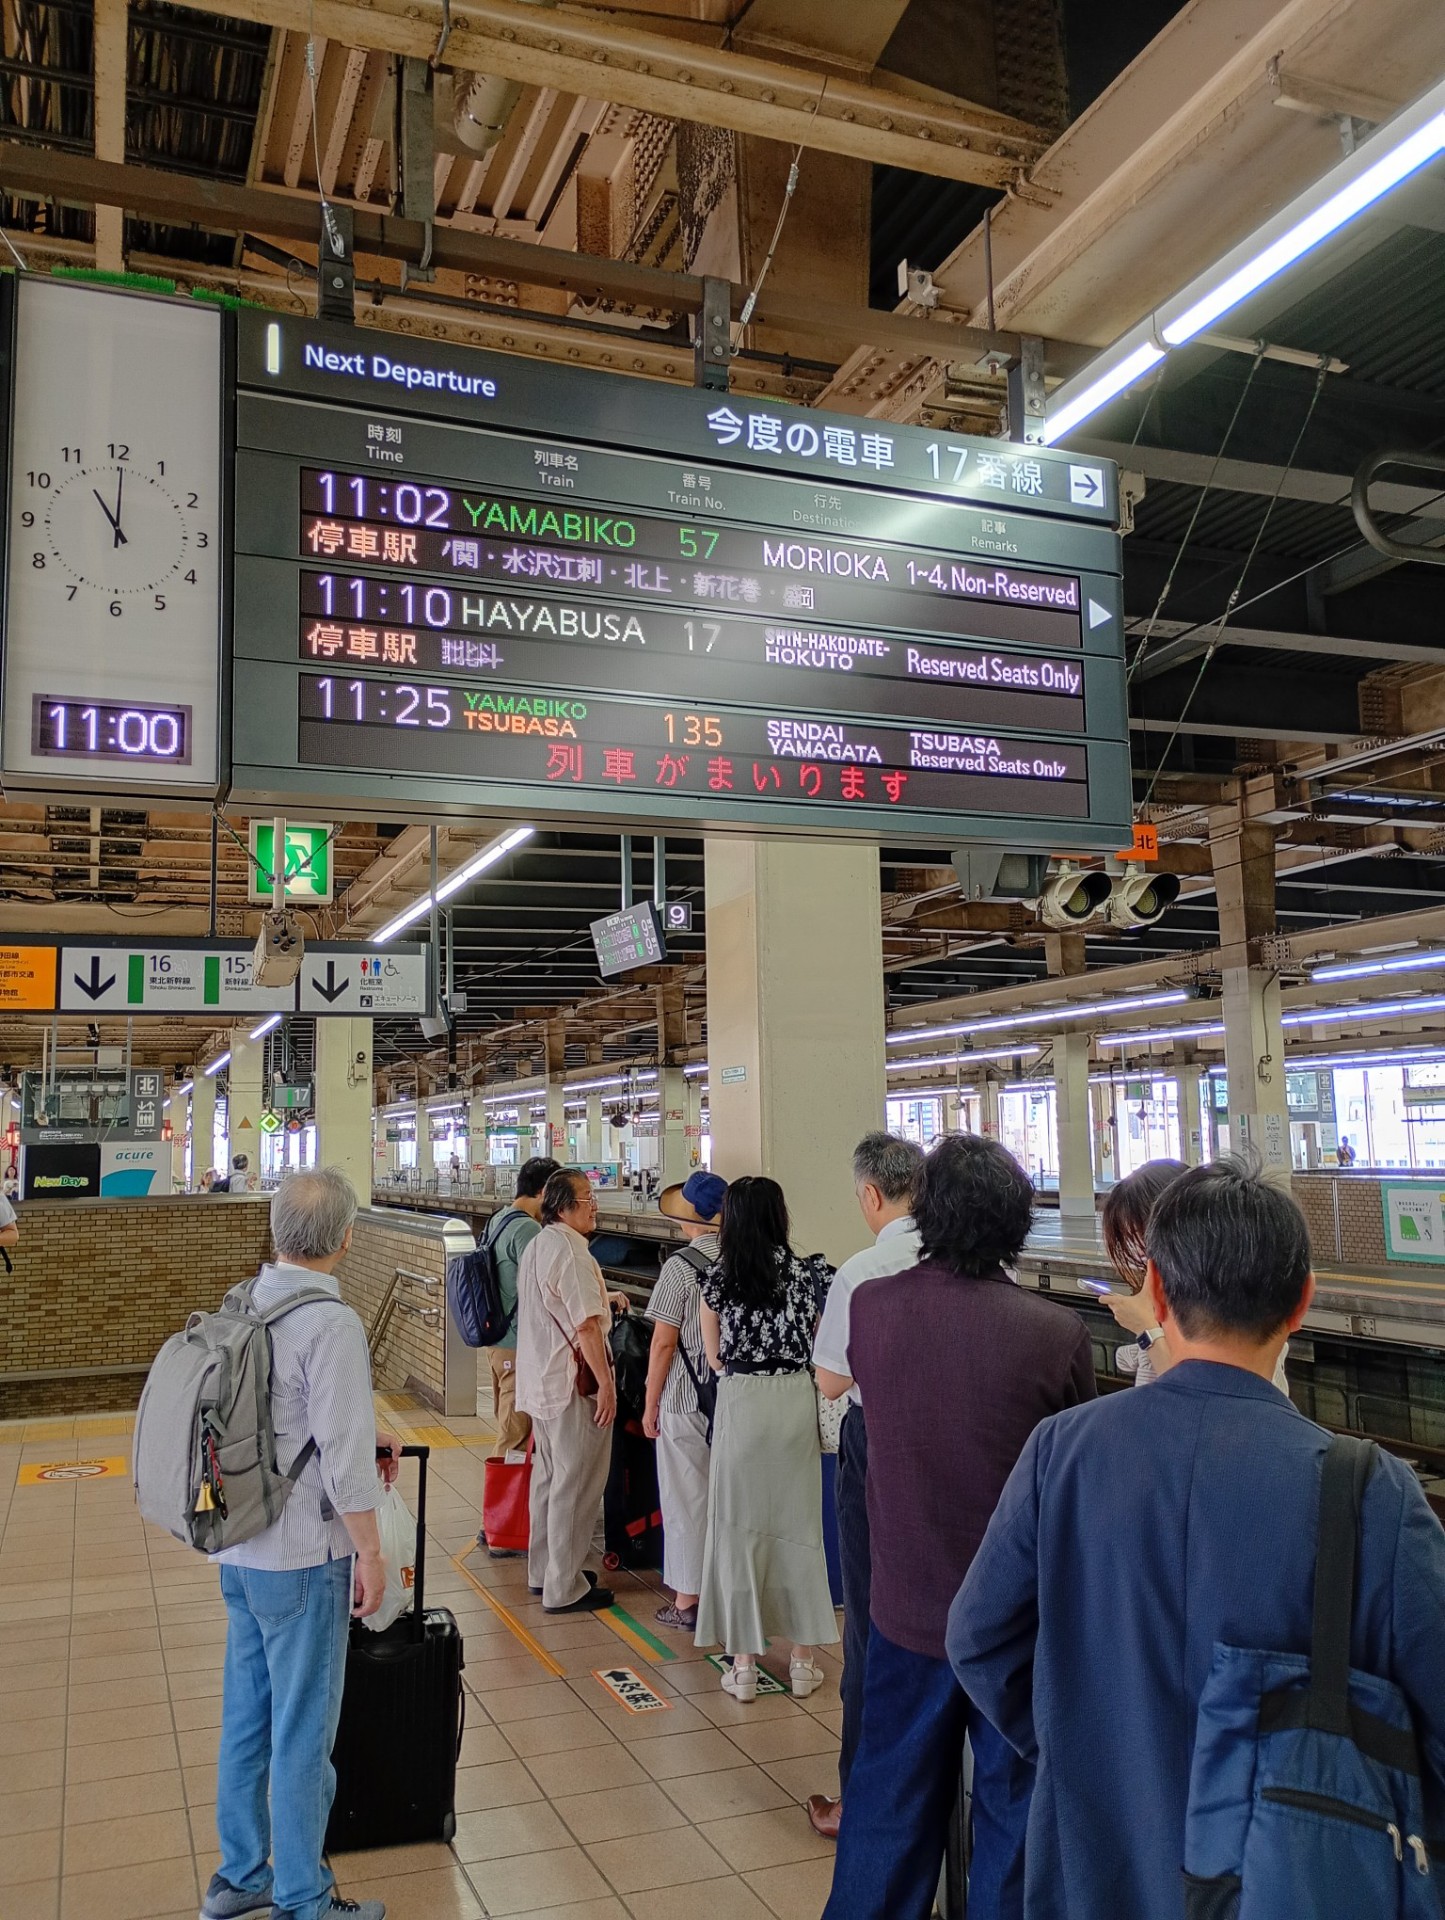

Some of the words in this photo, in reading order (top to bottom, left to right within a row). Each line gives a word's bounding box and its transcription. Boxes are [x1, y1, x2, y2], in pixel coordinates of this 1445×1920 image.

[304, 344, 365, 376] Next
[372, 356, 496, 397] Departure
[367, 423, 402, 444] 時刻
[61, 447, 81, 464] 11
[107, 444, 130, 461] 12
[365, 445, 404, 463] Time
[706, 406, 895, 470] 今度の電車
[925, 442, 1043, 496] 17番線
[157, 461, 165, 476] 1
[534, 450, 578, 471] 列車名
[27, 471, 51, 489] 10
[539, 471, 574, 488] Train
[682, 473, 712, 491] 番号
[187, 492, 199, 508] 2
[667, 491, 701, 507] Train
[704, 496, 726, 511] No.
[813, 494, 842, 511] 行先
[21, 511, 35, 528] 9
[792, 510, 861, 530] Destinatio
[981, 519, 1007, 535] 記事
[196, 532, 208, 548] 3
[308, 521, 418, 565] 停車駅
[319, 472, 450, 529] 11:02
[463, 499, 636, 548] YAMABIKO
[679, 527, 720, 559] 57
[763, 541, 890, 582] MORIOKA
[952, 568, 1077, 607] Non-Reserved
[971, 536, 1018, 553] Remarks
[32, 552, 46, 569] 8
[184, 569, 197, 585] 4
[65, 585, 78, 601] 7
[109, 601, 122, 617] 6
[154, 595, 166, 610] 5
[318, 575, 450, 628] 11:10
[462, 597, 646, 645] HAYABUSA
[683, 621, 721, 653] 17
[307, 623, 418, 665] 停車駅
[764, 628, 891, 657] SHIN-HAKODATE-
[765, 646, 853, 671] HOKUTO
[907, 648, 988, 682] Reserved
[990, 658, 1039, 687] Seats
[1042, 664, 1080, 694] Only
[318, 678, 451, 727] 11:25
[463, 692, 587, 720] YAMABIKO
[49, 706, 179, 755] 11:00
[463, 711, 577, 738] TSUBASA
[663, 713, 723, 747] 135
[767, 720, 844, 743] SENDAI
[767, 738, 882, 764] YAMAGATA
[910, 732, 1001, 756] TSUBASA
[910, 750, 985, 773] Reserved
[988, 757, 1030, 776] Seats
[1033, 760, 1066, 777] Only
[1136, 834, 1155, 850] 北
[670, 905, 685, 925] 9
[150, 955, 171, 972] 16
[225, 957, 253, 973] 15~
[139, 1077, 155, 1091] 北
[294, 1088, 310, 1102] 17
[115, 1151, 154, 1161] acure
[34, 1174, 90, 1188] NewDays
[633, 1702, 663, 1711] 2nd
